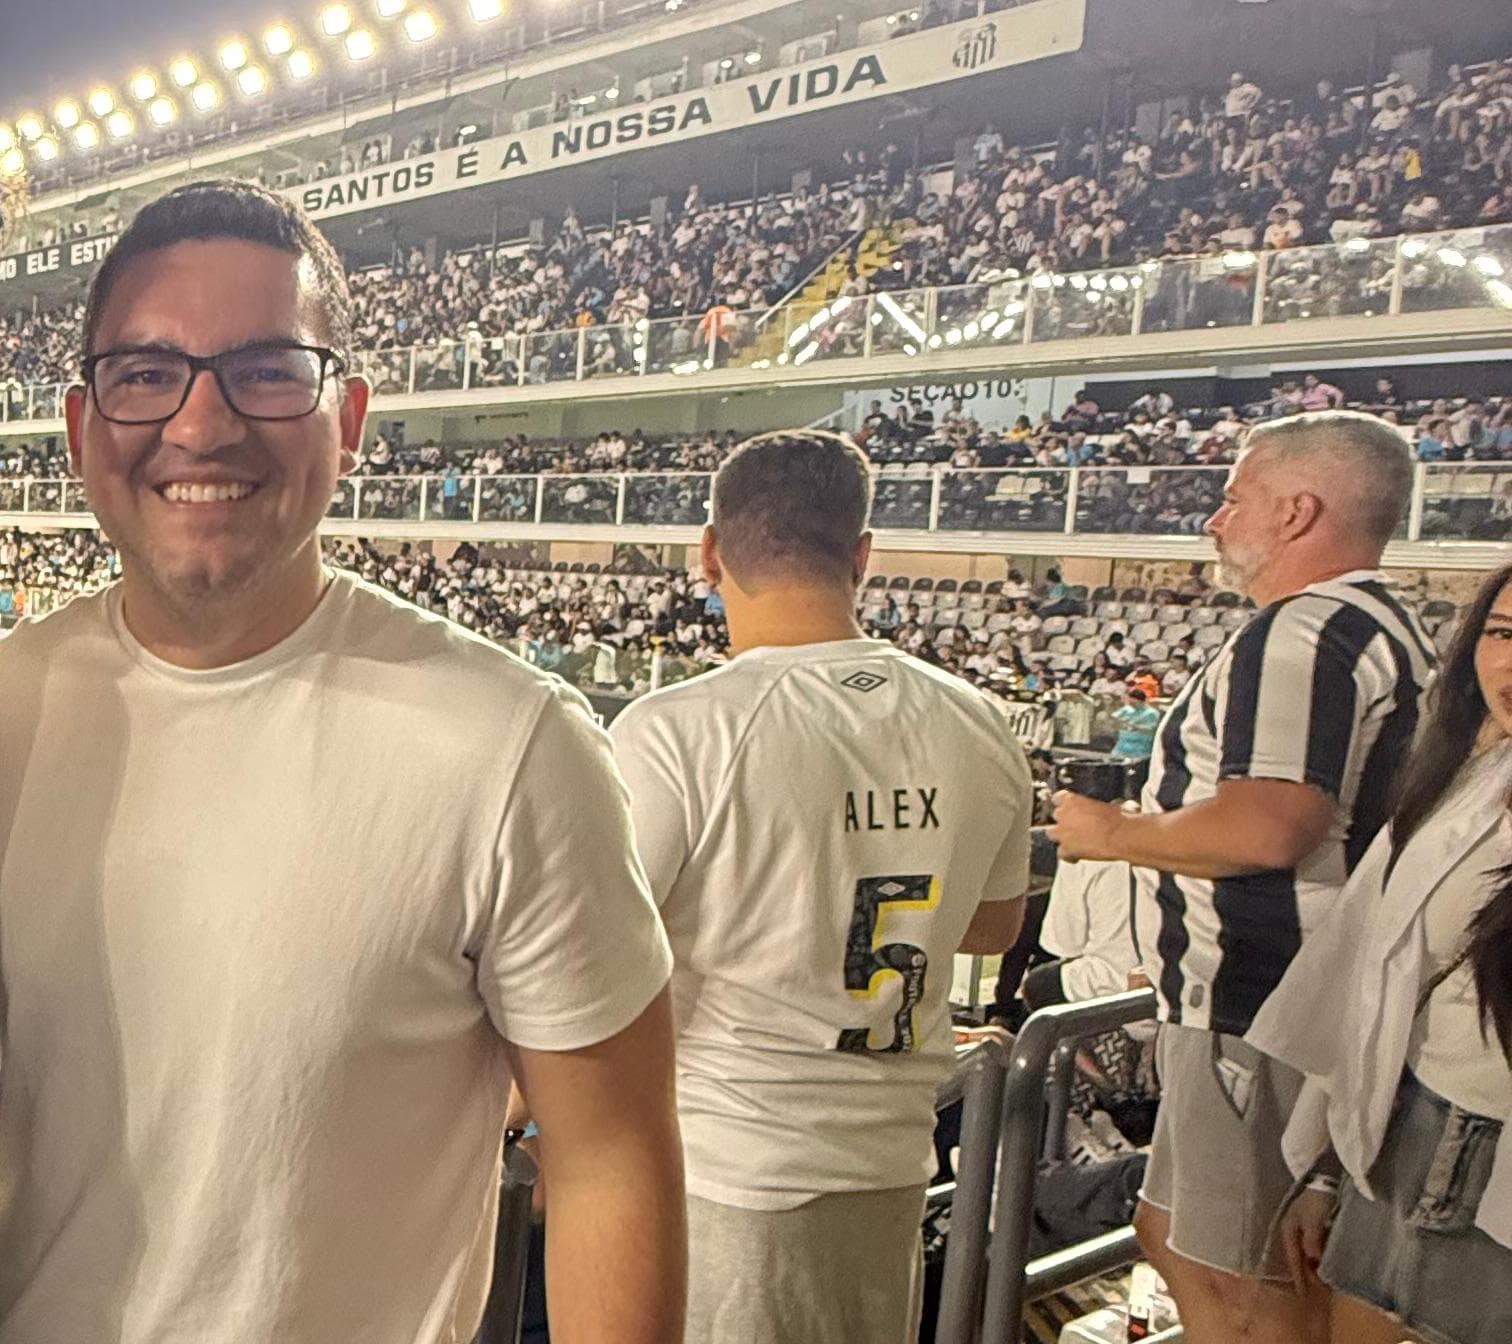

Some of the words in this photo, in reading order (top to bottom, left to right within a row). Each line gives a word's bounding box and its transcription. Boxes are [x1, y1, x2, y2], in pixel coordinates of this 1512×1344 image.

[303, 162, 435, 212] SANTOS
[456, 148, 479, 179] É
[501, 141, 528, 170] A
[551, 97, 712, 158] NOSSA
[747, 55, 887, 114] VIDA
[26, 248, 60, 275] ELE
[844, 787, 940, 833] ALEX
[836, 874, 944, 1053] 5
